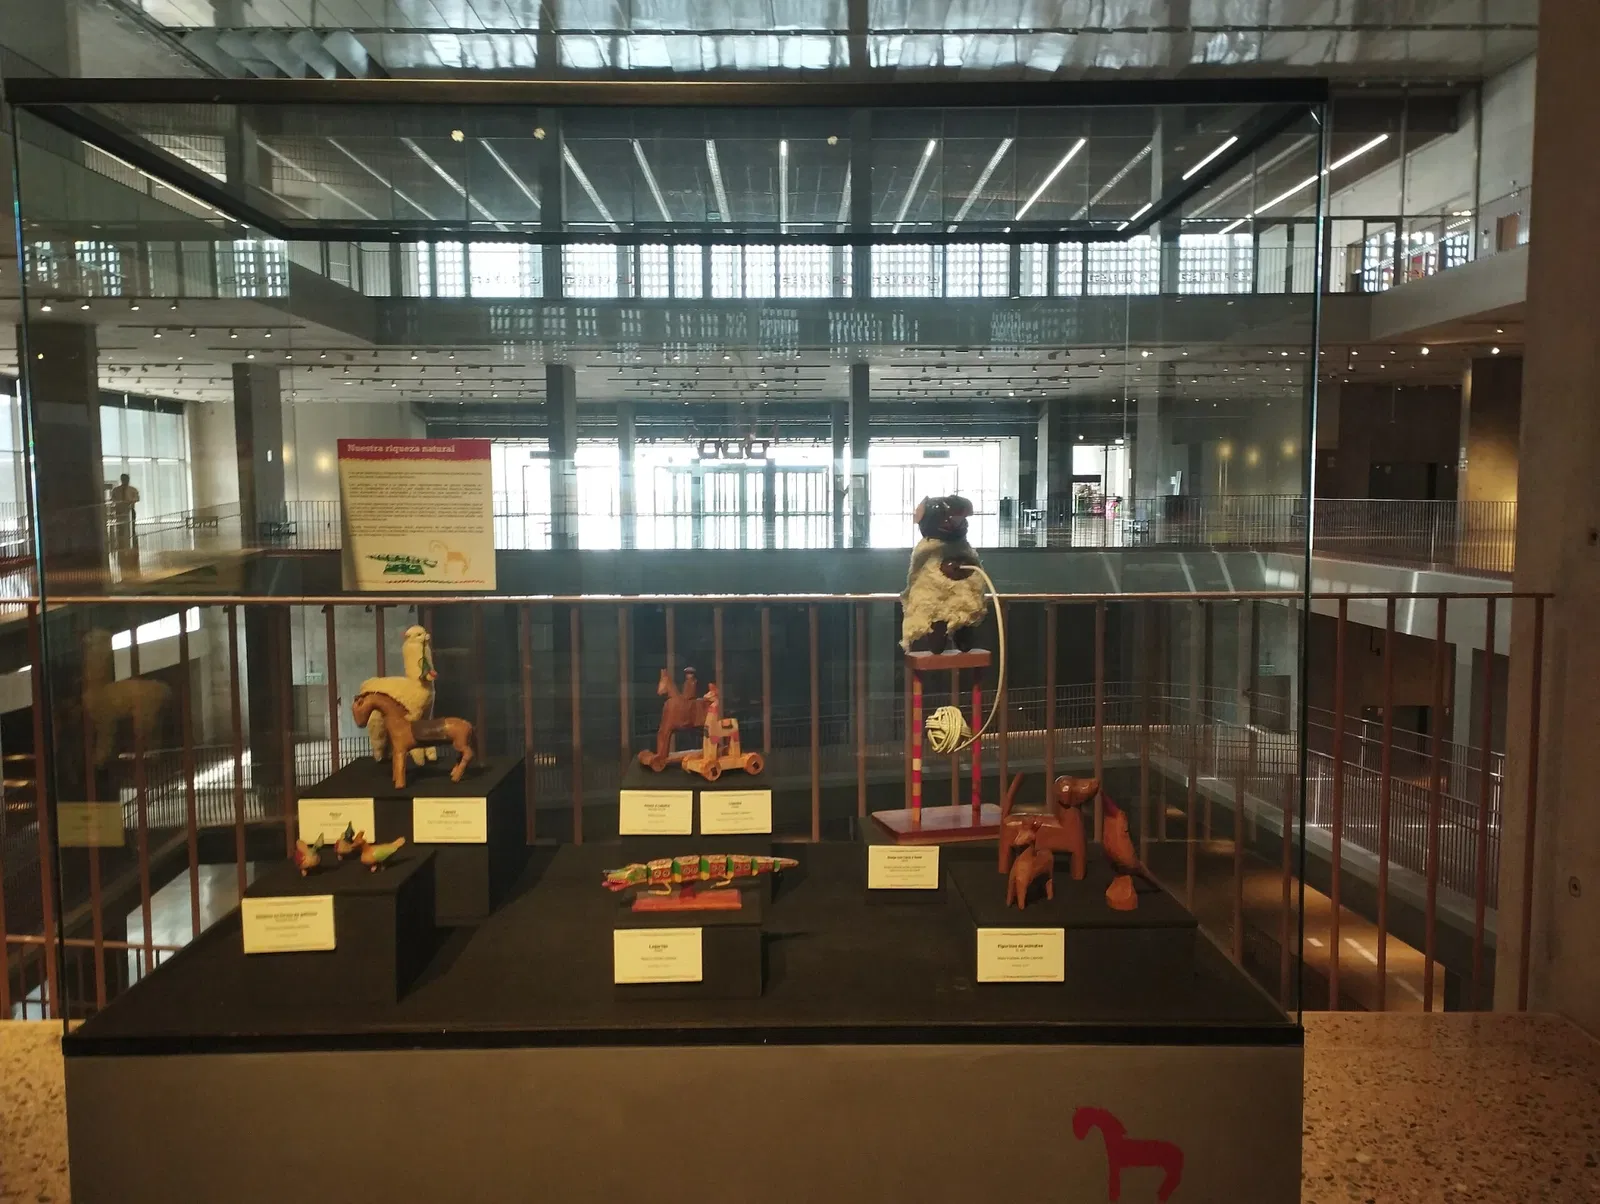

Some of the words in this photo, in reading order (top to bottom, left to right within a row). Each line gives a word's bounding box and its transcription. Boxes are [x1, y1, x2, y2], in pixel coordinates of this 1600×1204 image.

[347, 443, 384, 453] Nuestra
[385, 444, 420, 455] riqueza
[422, 444, 455, 453] natural
